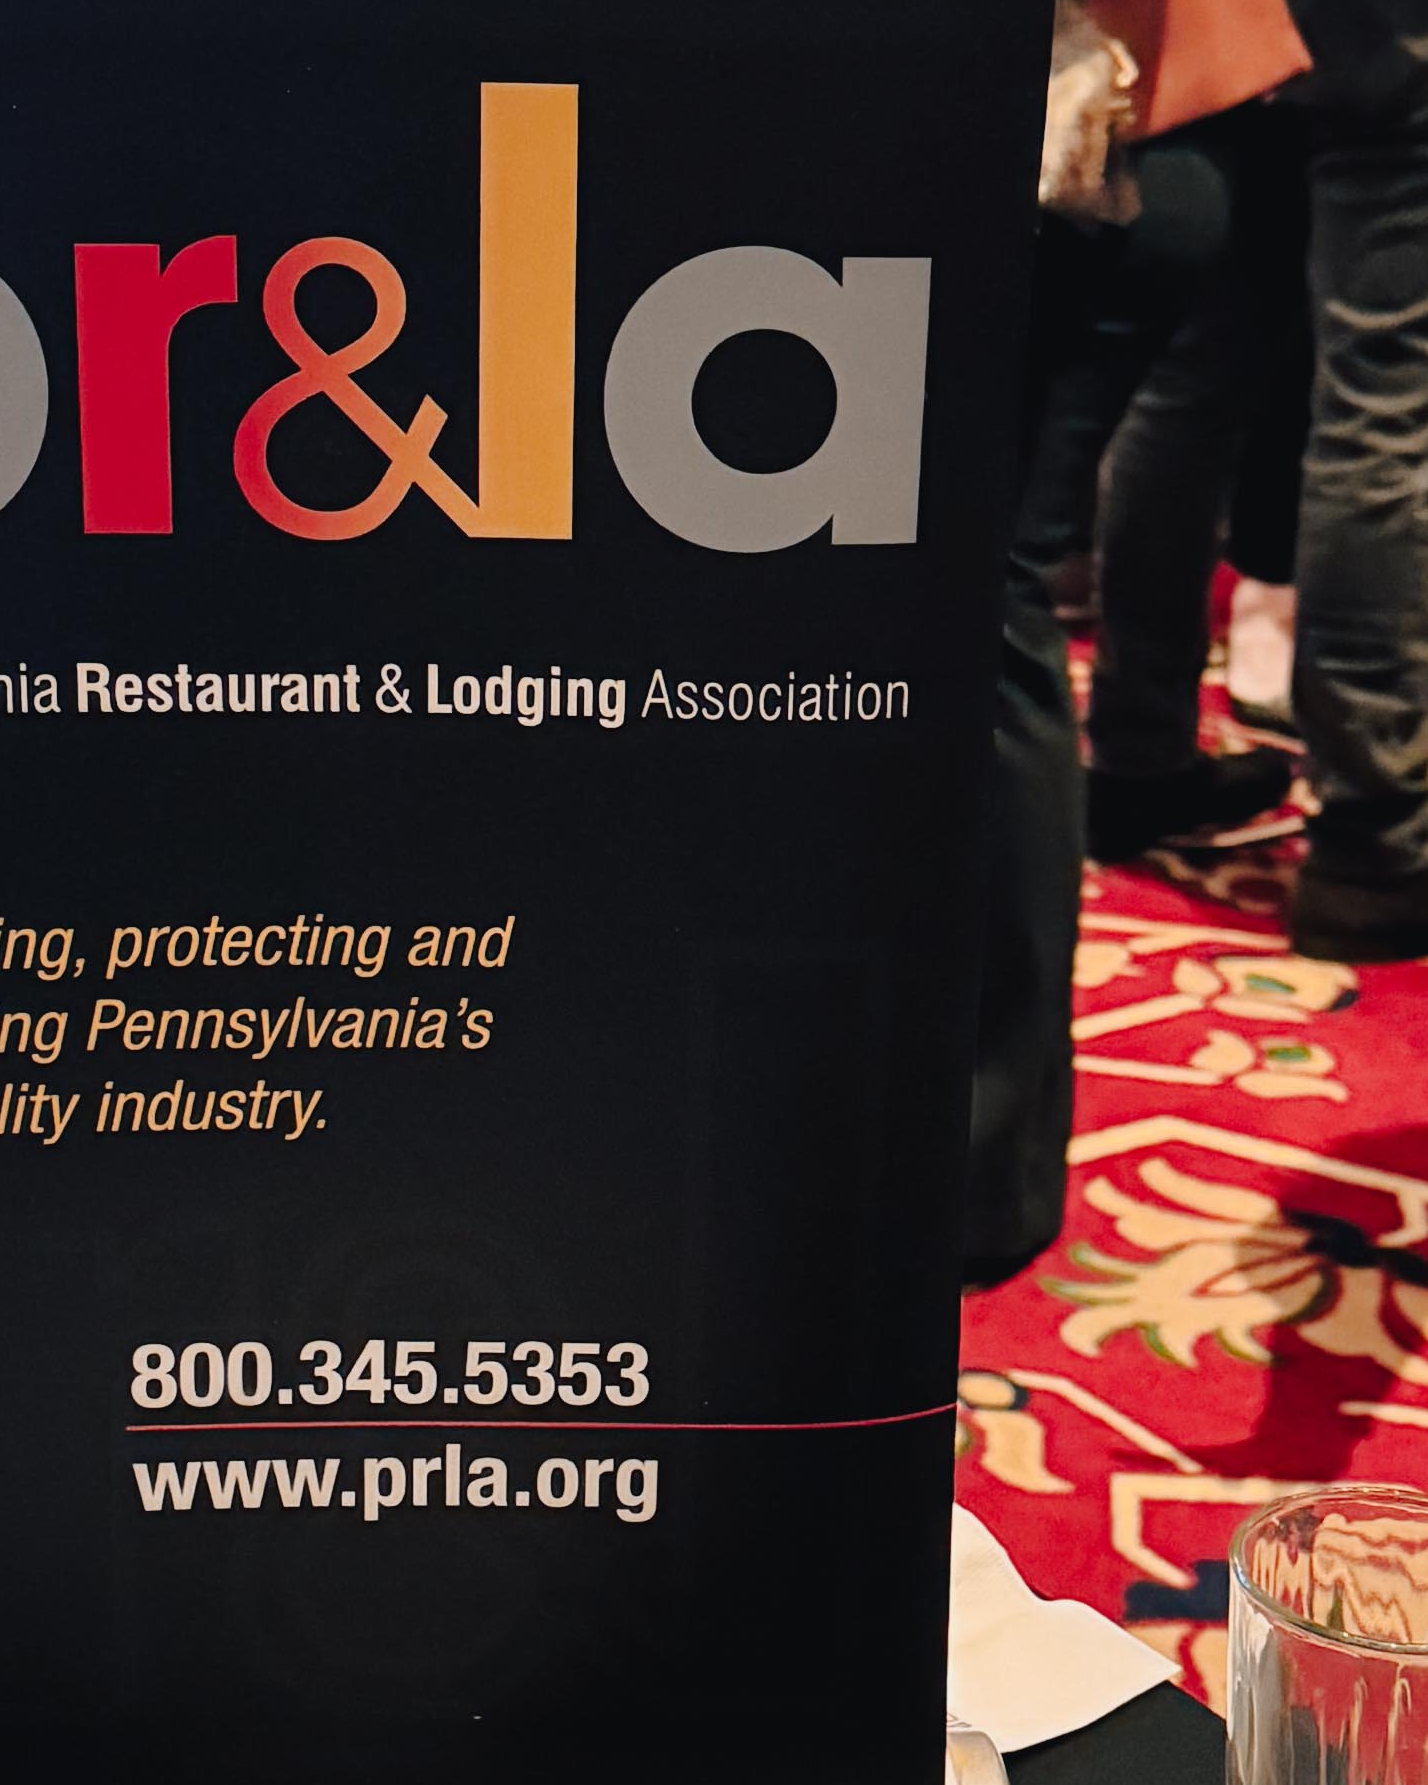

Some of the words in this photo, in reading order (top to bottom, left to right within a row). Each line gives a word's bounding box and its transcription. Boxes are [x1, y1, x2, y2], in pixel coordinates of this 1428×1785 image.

[76, 662, 361, 713] Restaurant
[375, 663, 413, 714] &
[427, 663, 626, 729] Lodging
[641, 668, 910, 723] Association
[105, 913, 392, 980] protecting
[407, 915, 516, 968] and
[86, 996, 494, 1061] Pennsylvania's
[96, 1079, 329, 1142] industry.
[130, 1339, 651, 1410] 800.345.5353
[132, 1443, 660, 1524] www.prla.org
